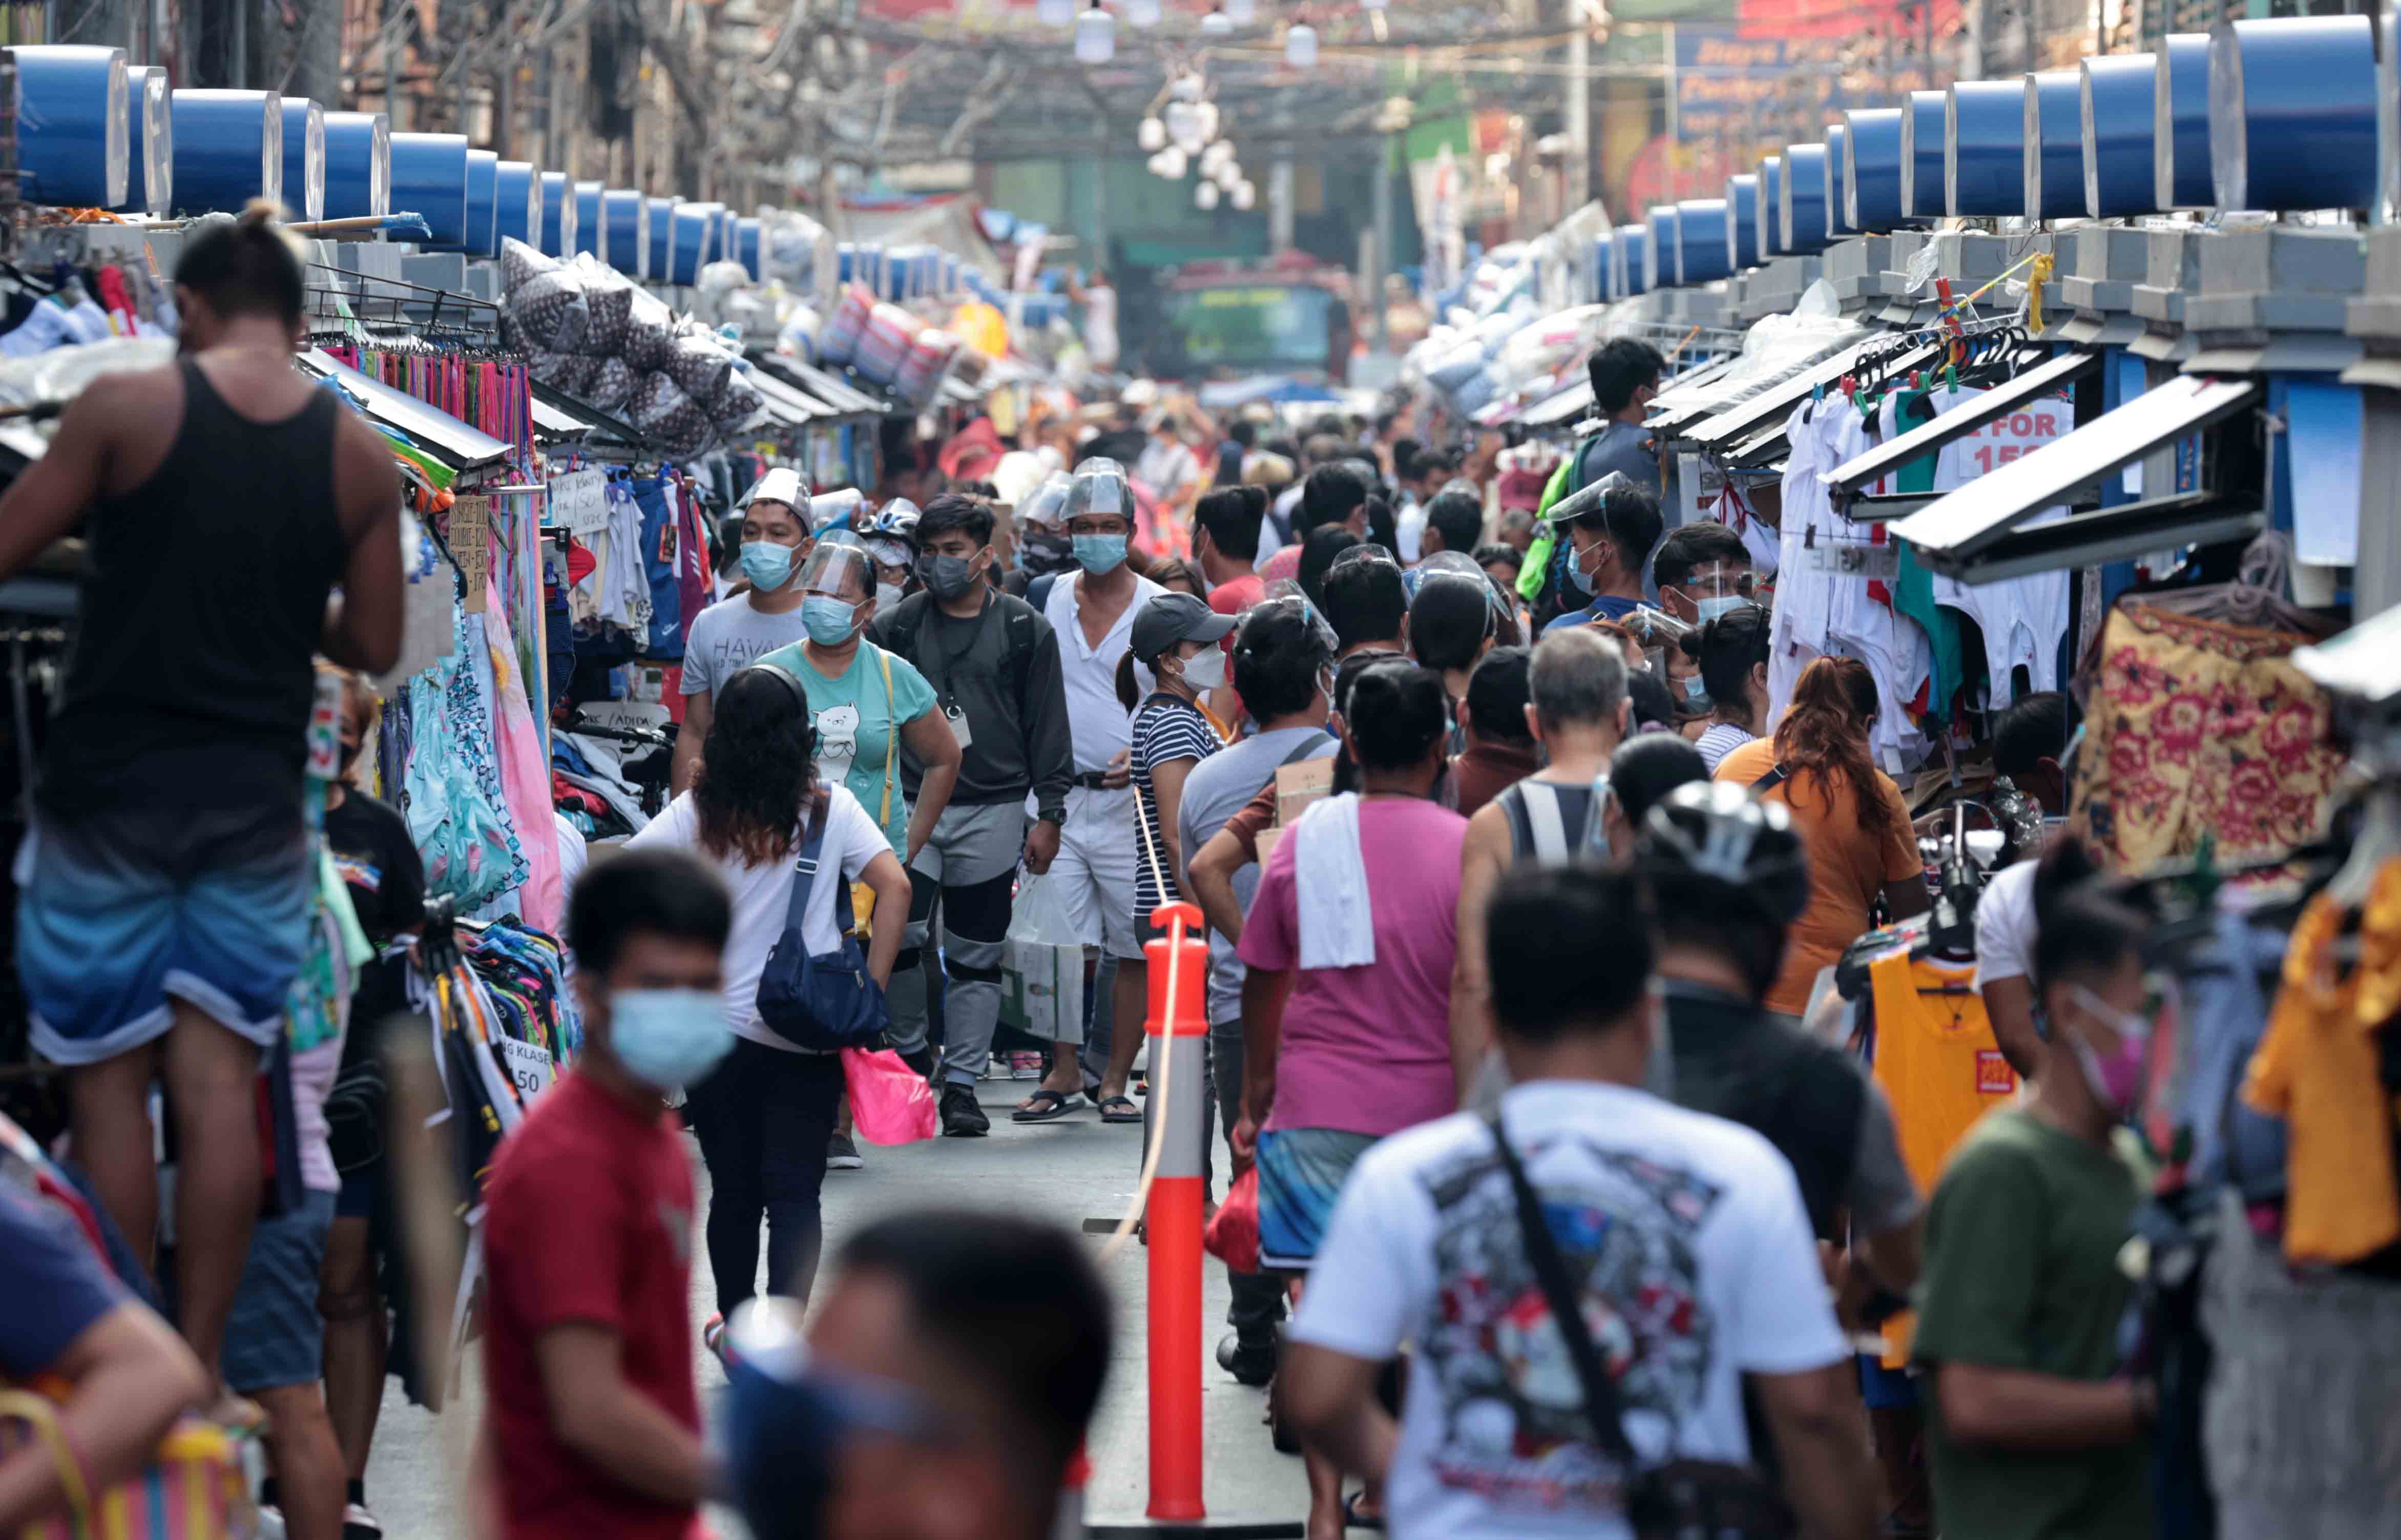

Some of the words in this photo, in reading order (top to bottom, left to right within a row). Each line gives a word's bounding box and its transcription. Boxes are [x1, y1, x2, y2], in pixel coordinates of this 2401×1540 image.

[1992, 413, 2057, 437] FOR
[1975, 445, 2041, 474] 15
[516, 1045, 550, 1065] KLASE
